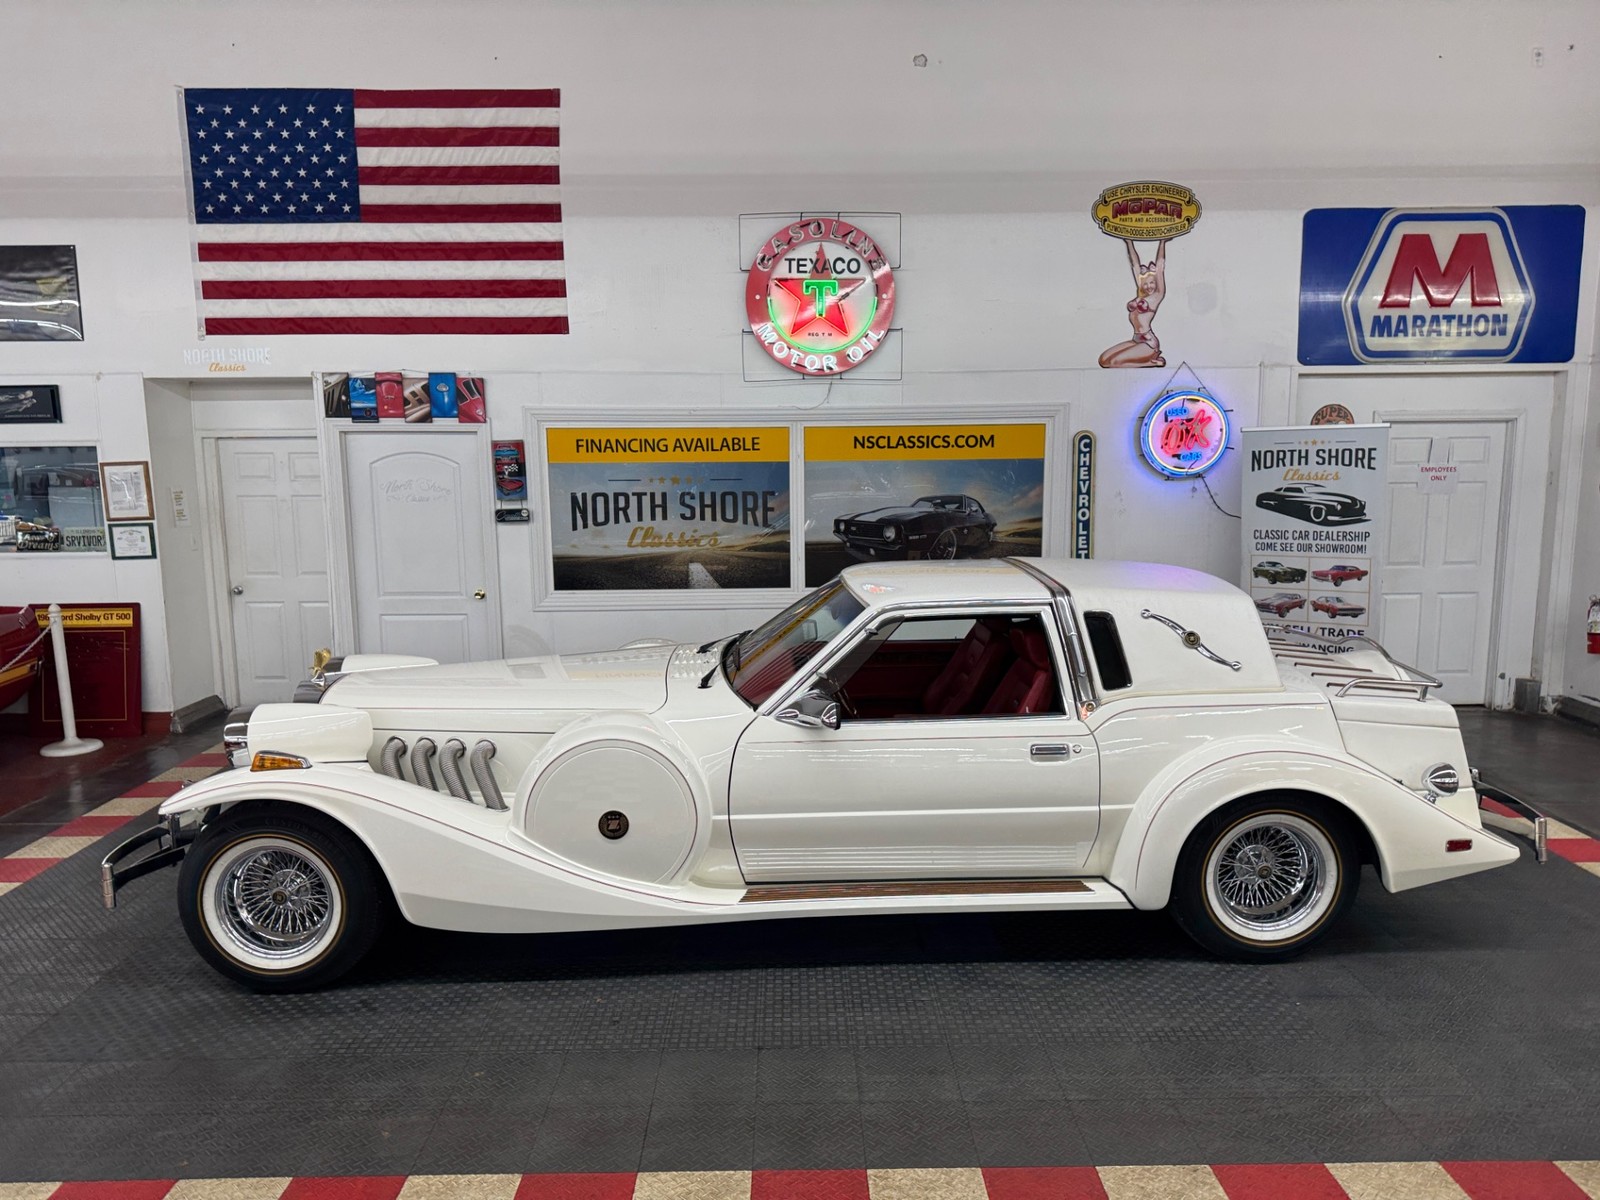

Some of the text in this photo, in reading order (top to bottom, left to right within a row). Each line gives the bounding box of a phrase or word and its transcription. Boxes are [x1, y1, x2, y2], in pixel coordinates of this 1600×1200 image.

[1107, 184, 1187, 199] USE CHRYSLER ENGINEERED
[1112, 197, 1183, 220] MOPAR
[784, 257, 861, 275] TEXACO
[1378, 233, 1503, 308] M
[1370, 313, 1508, 337] MARATHON
[183, 346, 272, 365] NORTH SHORE
[757, 323, 885, 373] MOTOR OIL
[208, 361, 247, 372] Classics
[1167, 407, 1188, 416] USED
[575, 437, 761, 453] FINANCING AVAILABLE
[853, 434, 995, 449] NSCLASSICS.COM
[1251, 447, 1377, 472] NORTH SHORE
[1282, 468, 1341, 481] Classics
[1077, 438, 1091, 560] CHEVROLET
[570, 490, 777, 531] NORTH SHORE
[65, 535, 103, 547] SRVIVOR
[626, 526, 722, 549] Classics
[1253, 529, 1371, 542] CLASSIC CAR DEALERSHIP
[19, 540, 60, 550] Dreams
[1255, 542, 1367, 554] COME SEE OUR SHOWROOM!
[75, 613, 102, 622] Shelby
[115, 612, 131, 620] 500
